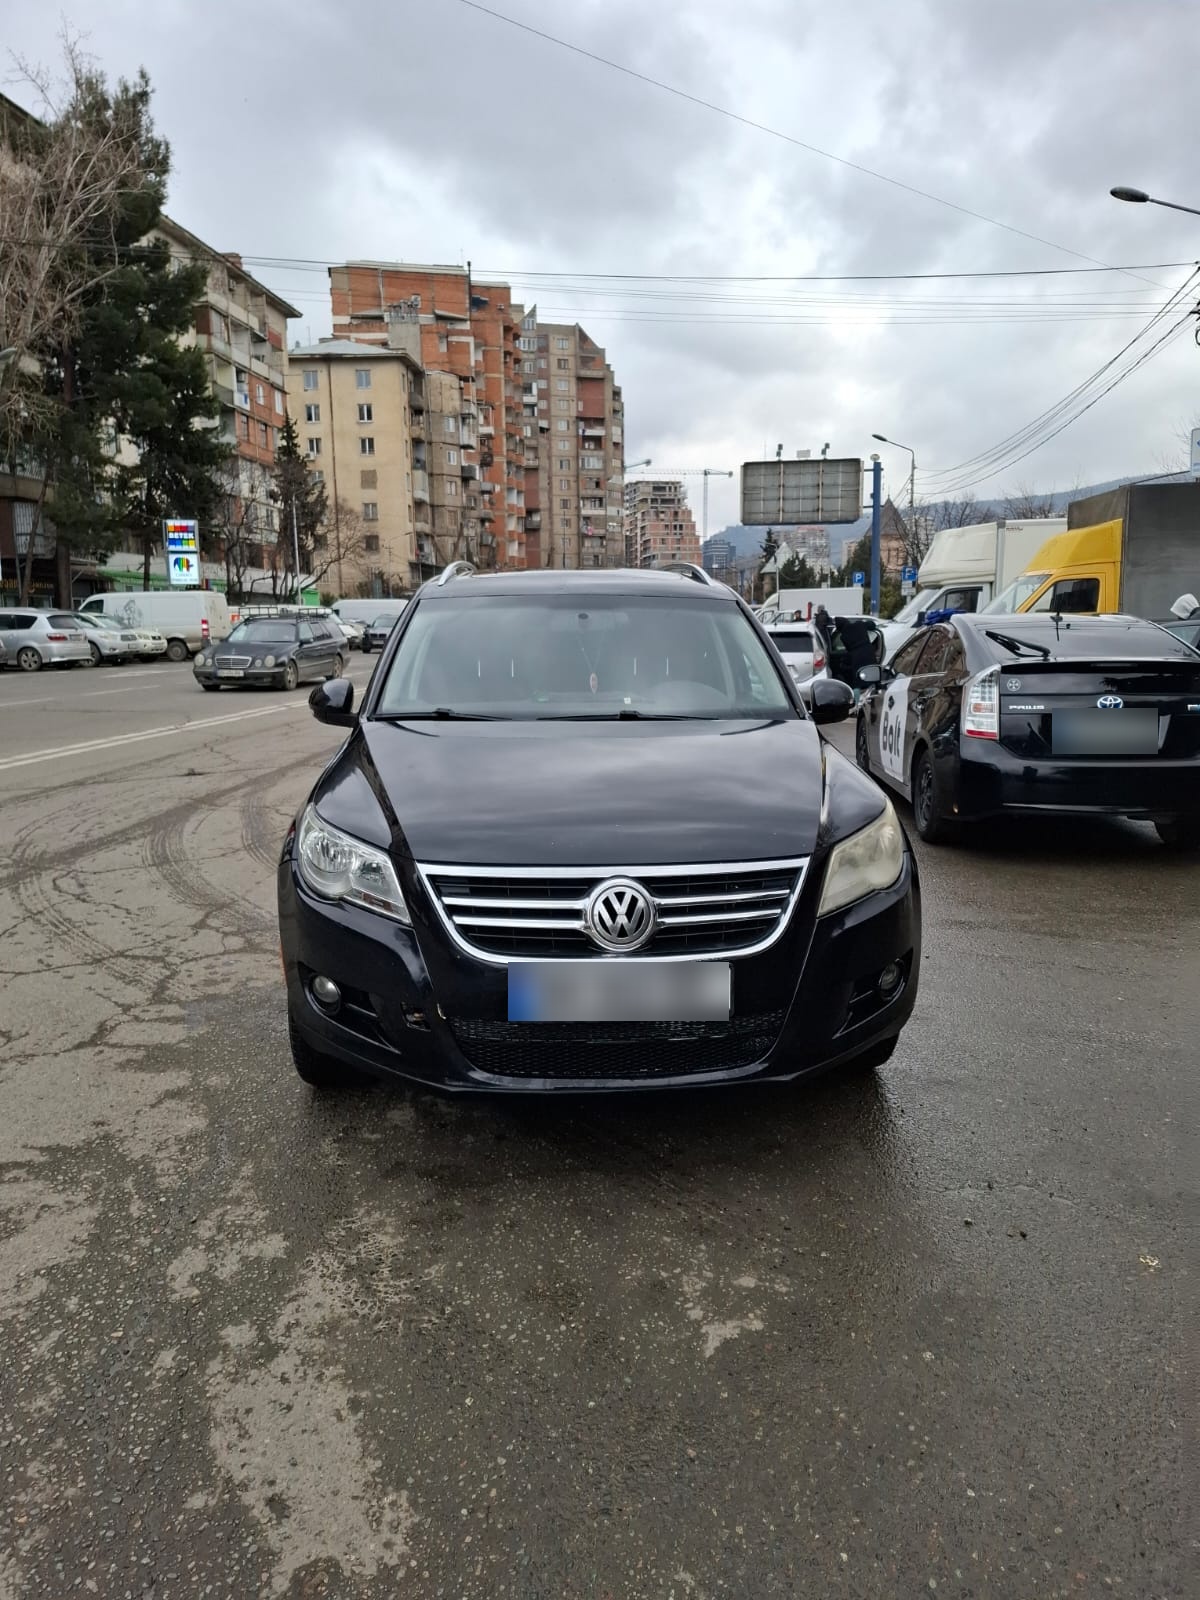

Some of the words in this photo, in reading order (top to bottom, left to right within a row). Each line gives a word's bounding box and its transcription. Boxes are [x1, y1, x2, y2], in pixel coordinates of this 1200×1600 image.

[855, 573, 862, 582] P
[882, 711, 901, 767] Bolt
[593, 887, 649, 943] VW
